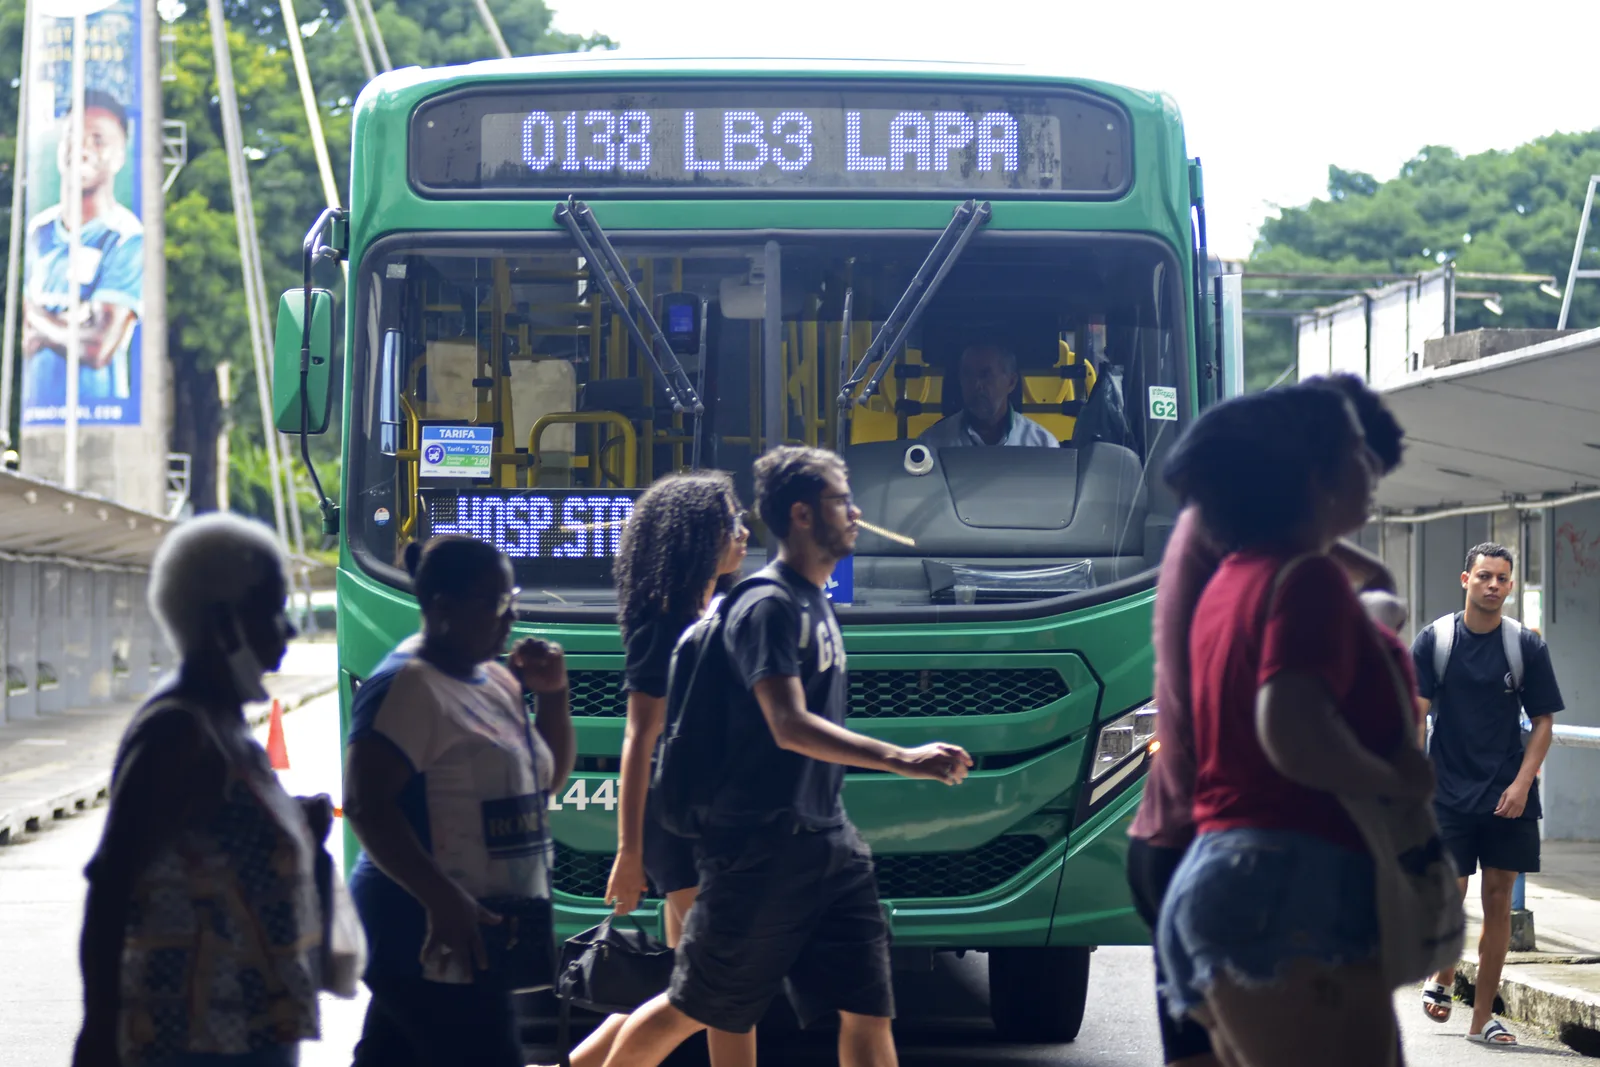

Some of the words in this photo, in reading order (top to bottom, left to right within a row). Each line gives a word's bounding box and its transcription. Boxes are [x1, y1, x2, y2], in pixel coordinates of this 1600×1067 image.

[522, 110, 651, 171] 0138
[683, 110, 813, 171] LB3
[846, 110, 1019, 171] LAPA
[1152, 400, 1176, 417] G2
[439, 429, 475, 439] TARIFA
